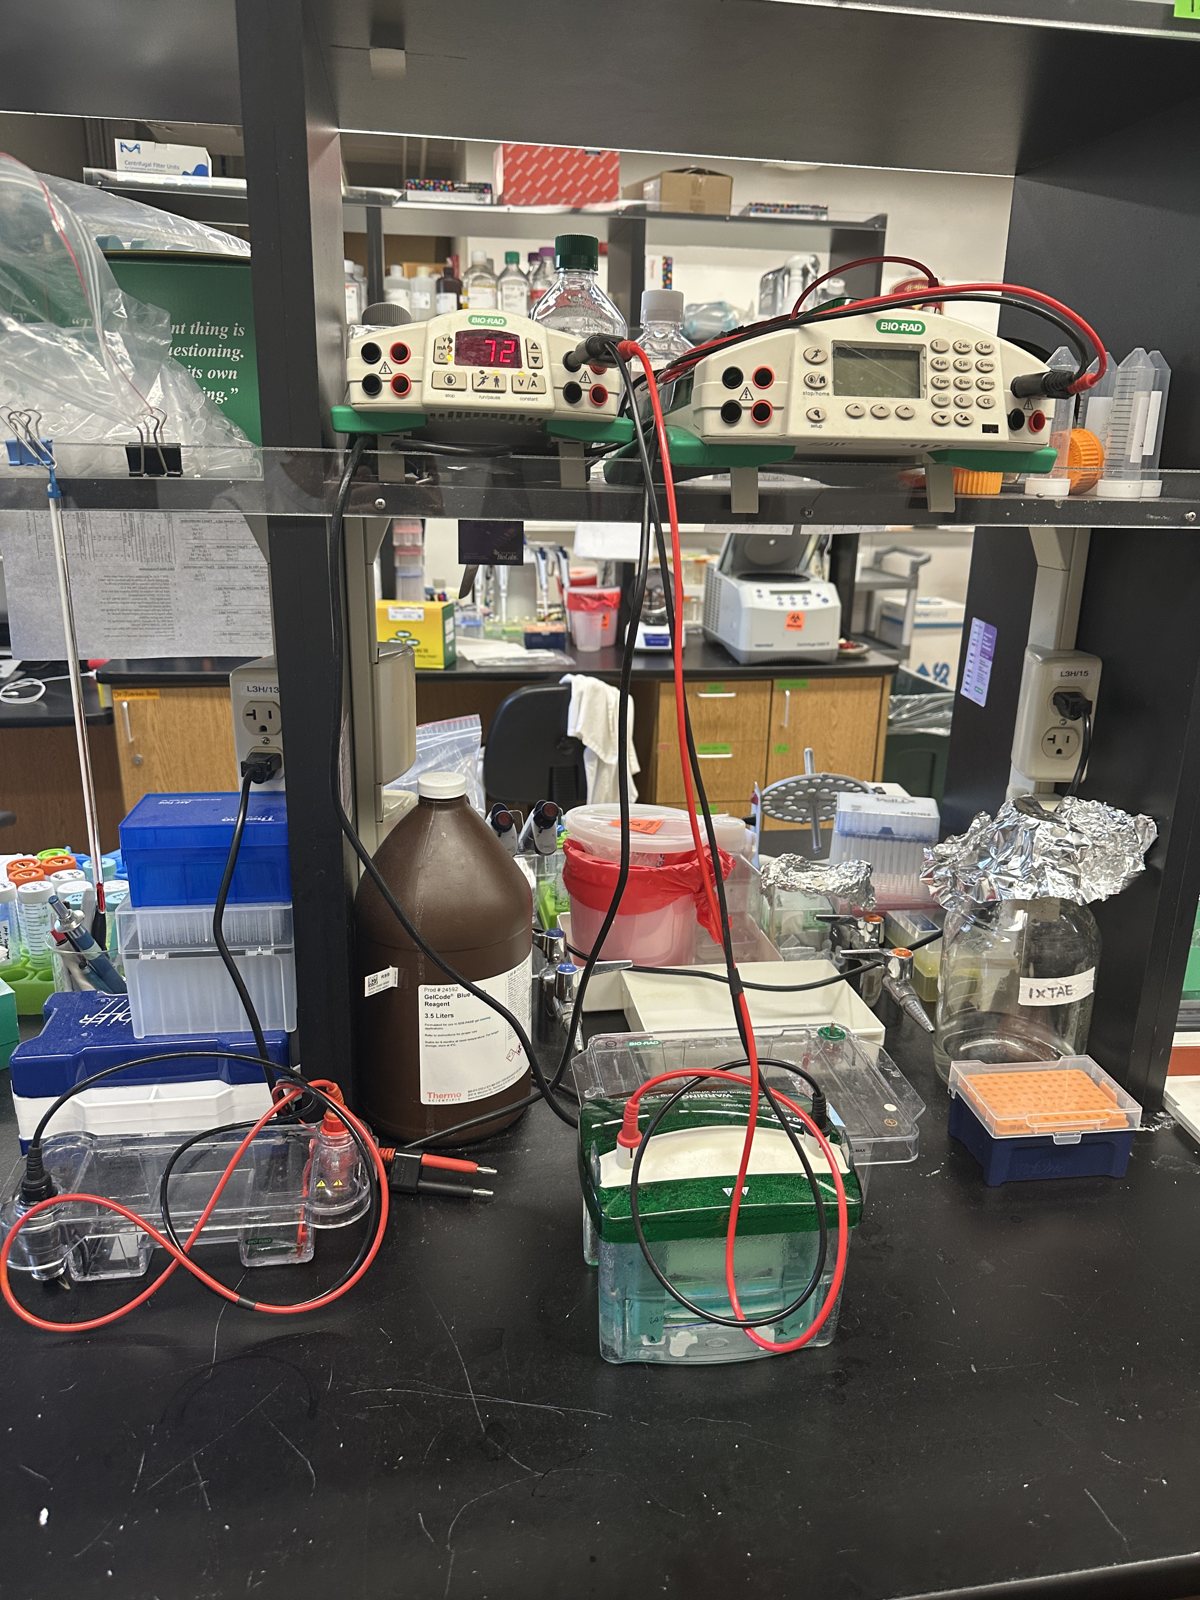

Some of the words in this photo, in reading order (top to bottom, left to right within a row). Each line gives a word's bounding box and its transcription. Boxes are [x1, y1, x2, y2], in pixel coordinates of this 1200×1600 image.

[124, 160, 152, 168] Centrifugal
[190, 321, 229, 340] thing
[233, 322, 246, 337] is
[168, 343, 244, 362] estioning.
[484, 340, 516, 363] 72
[207, 369, 238, 380] own
[1060, 670, 1089, 678] L3H/15
[247, 686, 280, 694] L3H/13
[427, 1091, 462, 1099] Thermo
